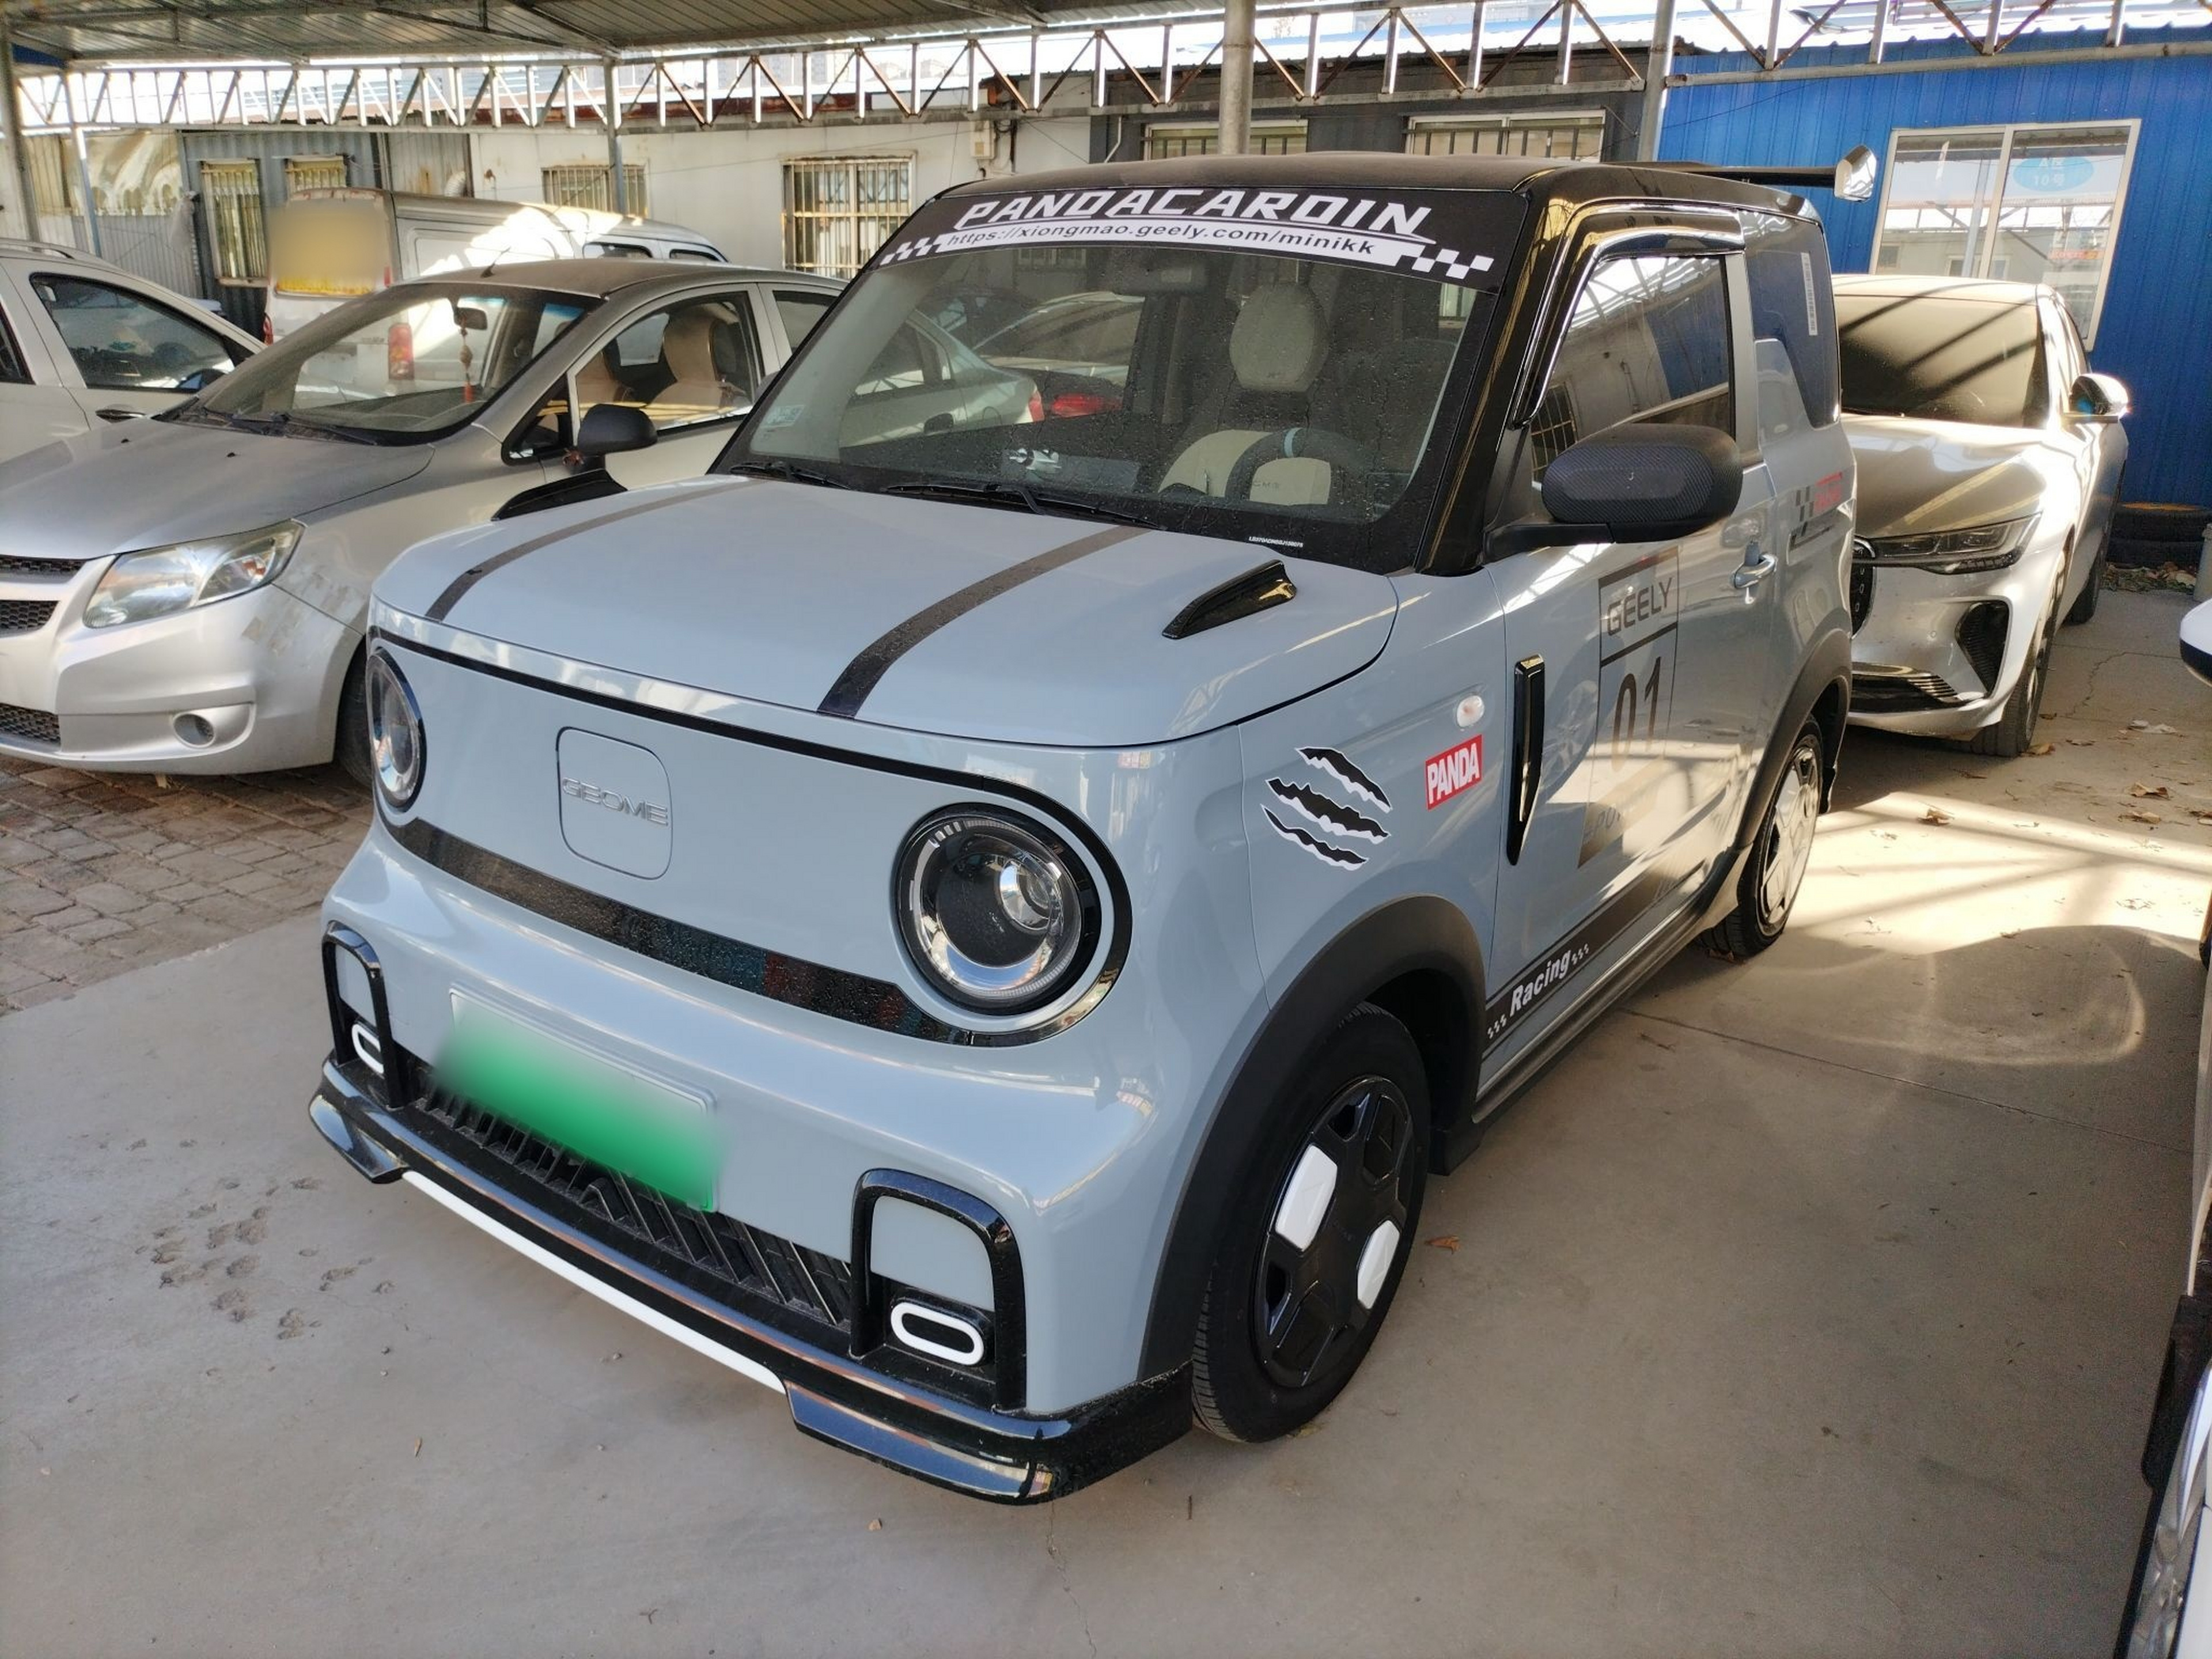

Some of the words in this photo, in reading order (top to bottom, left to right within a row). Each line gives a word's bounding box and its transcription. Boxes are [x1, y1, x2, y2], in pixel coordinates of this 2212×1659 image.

[947, 224, 1376, 255] https://xiongmao.geely.com/minikk
[1606, 577, 1673, 636] GEELY
[1611, 656, 1661, 773] 01
[562, 777, 669, 827] GEOME
[1426, 742, 1480, 805] PANDA
[1509, 949, 1571, 1017] Racing
